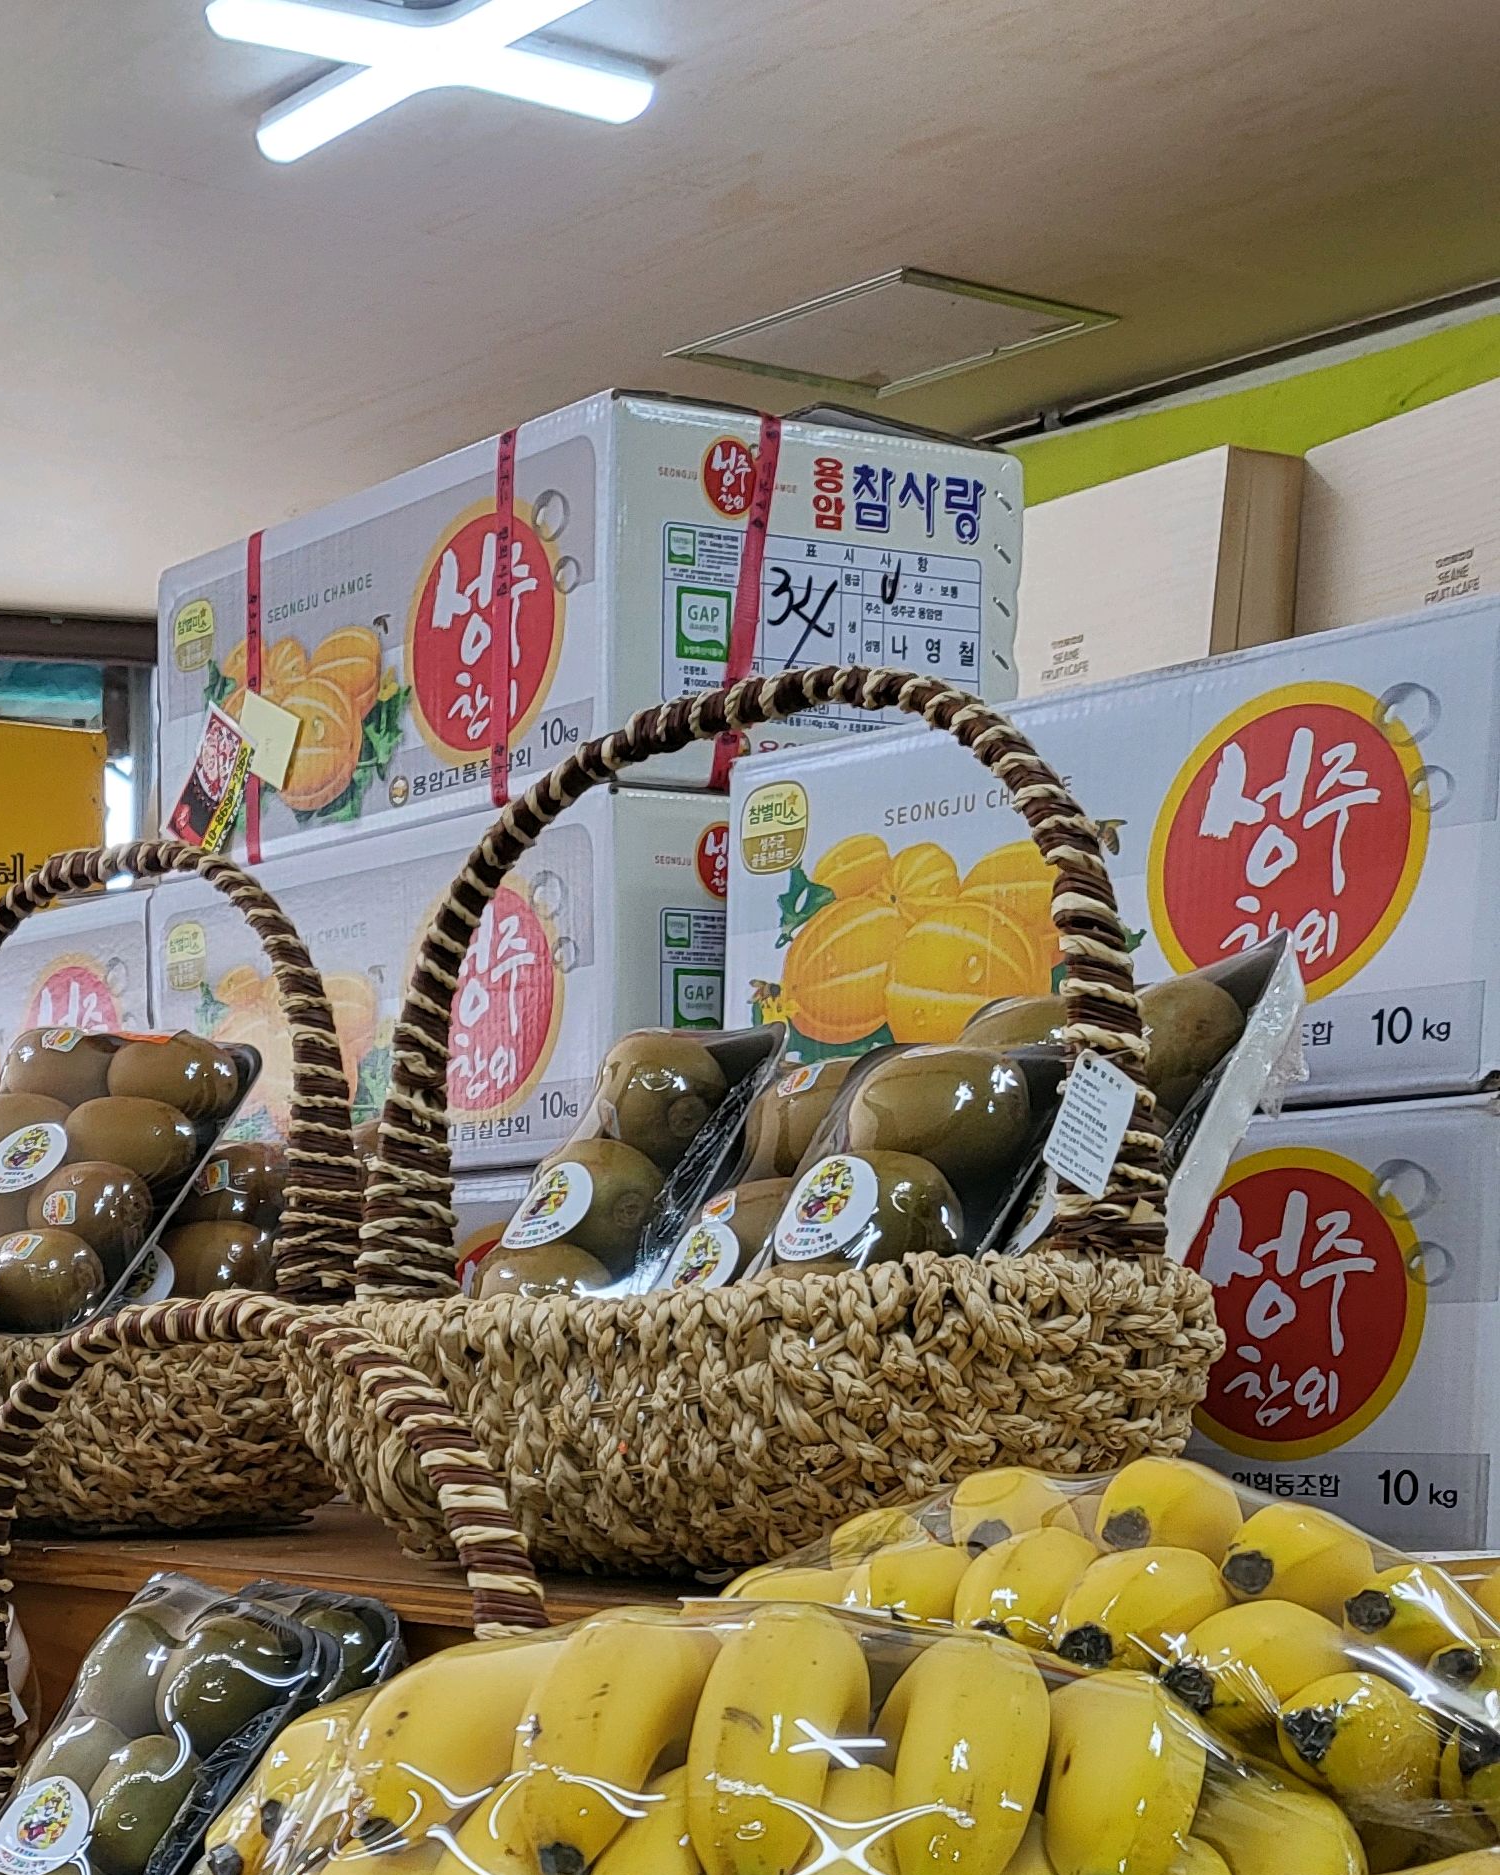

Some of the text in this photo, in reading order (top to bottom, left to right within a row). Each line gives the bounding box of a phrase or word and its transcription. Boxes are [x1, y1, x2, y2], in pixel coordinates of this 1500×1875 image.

[658, 466, 698, 481] SEONGJU
[813, 457, 845, 532] 용암
[852, 463, 985, 545] 참사랑
[267, 573, 374, 625] SEONGJU CHAMOE
[687, 604, 720, 623] GAP
[884, 793, 976, 828] SEONGJU
[1199, 727, 1382, 897] 성주
[683, 984, 714, 1001] GAP
[1201, 1190, 1377, 1357] 성주
[1223, 1345, 1340, 1429] 참외
